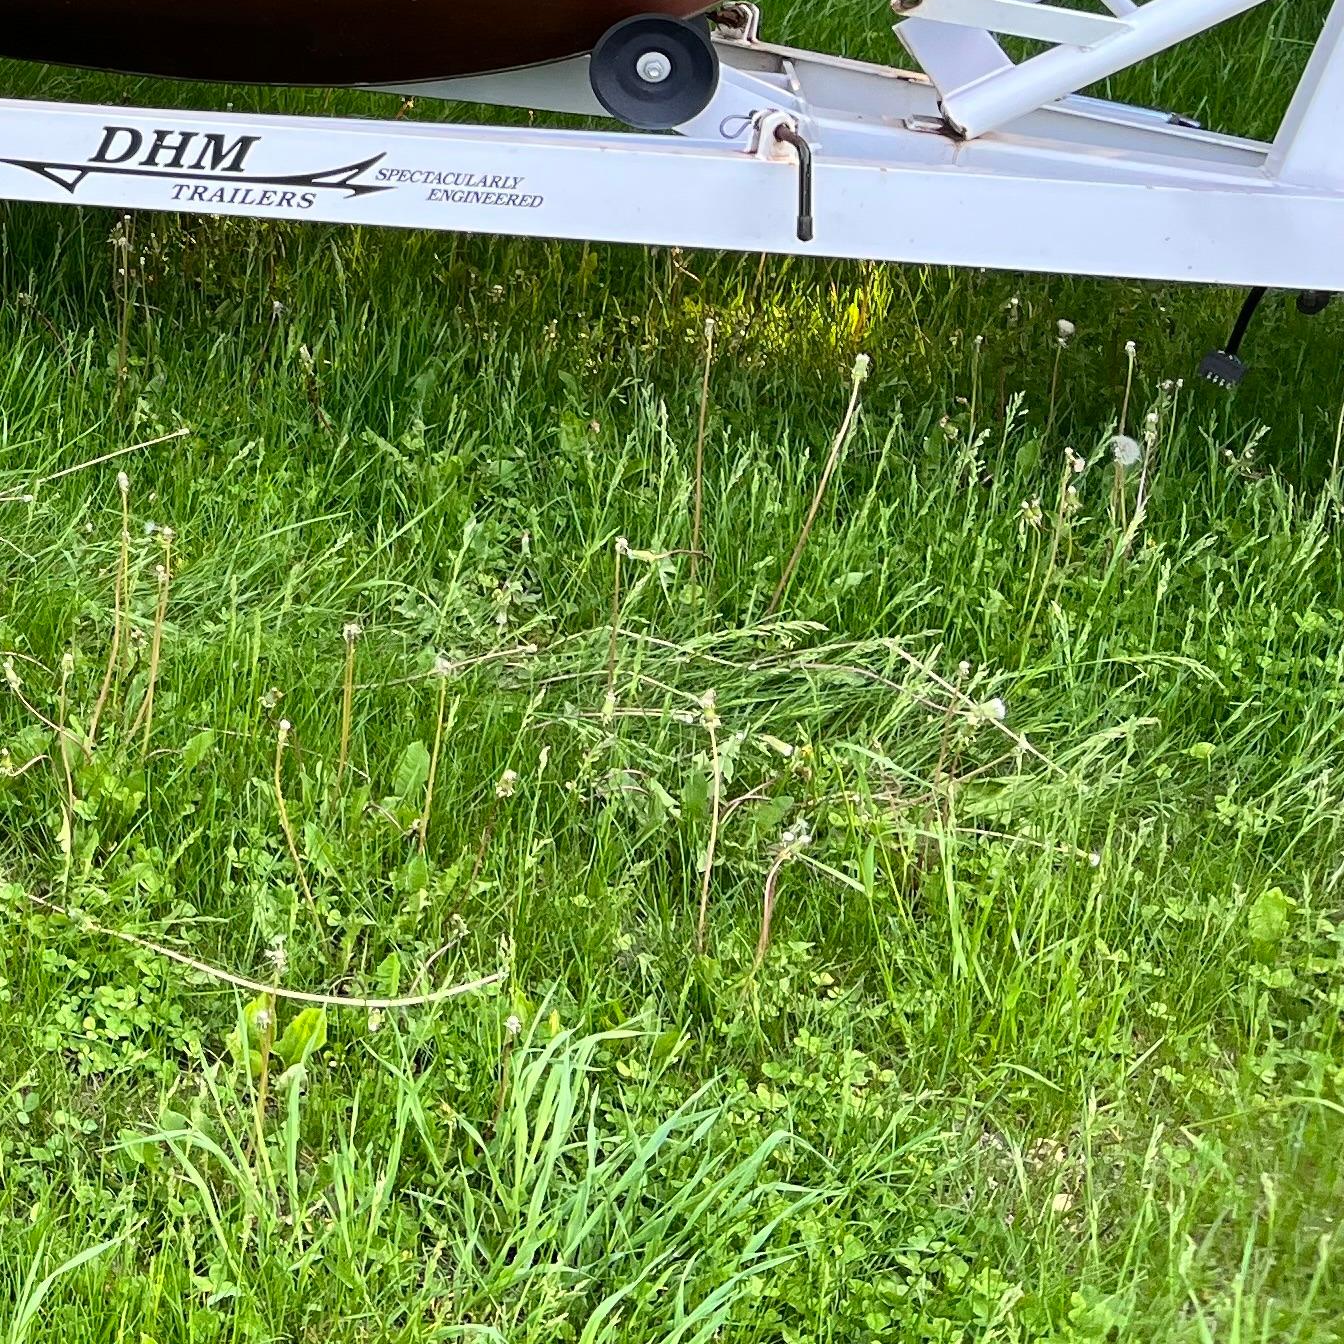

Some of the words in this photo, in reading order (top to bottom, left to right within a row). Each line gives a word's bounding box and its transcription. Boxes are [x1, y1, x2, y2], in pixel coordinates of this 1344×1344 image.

[87, 125, 263, 173] DHM
[375, 167, 526, 190] SPECTACULARLY
[170, 183, 317, 209] TRAILERS
[425, 187, 545, 208] ENGINEERED
